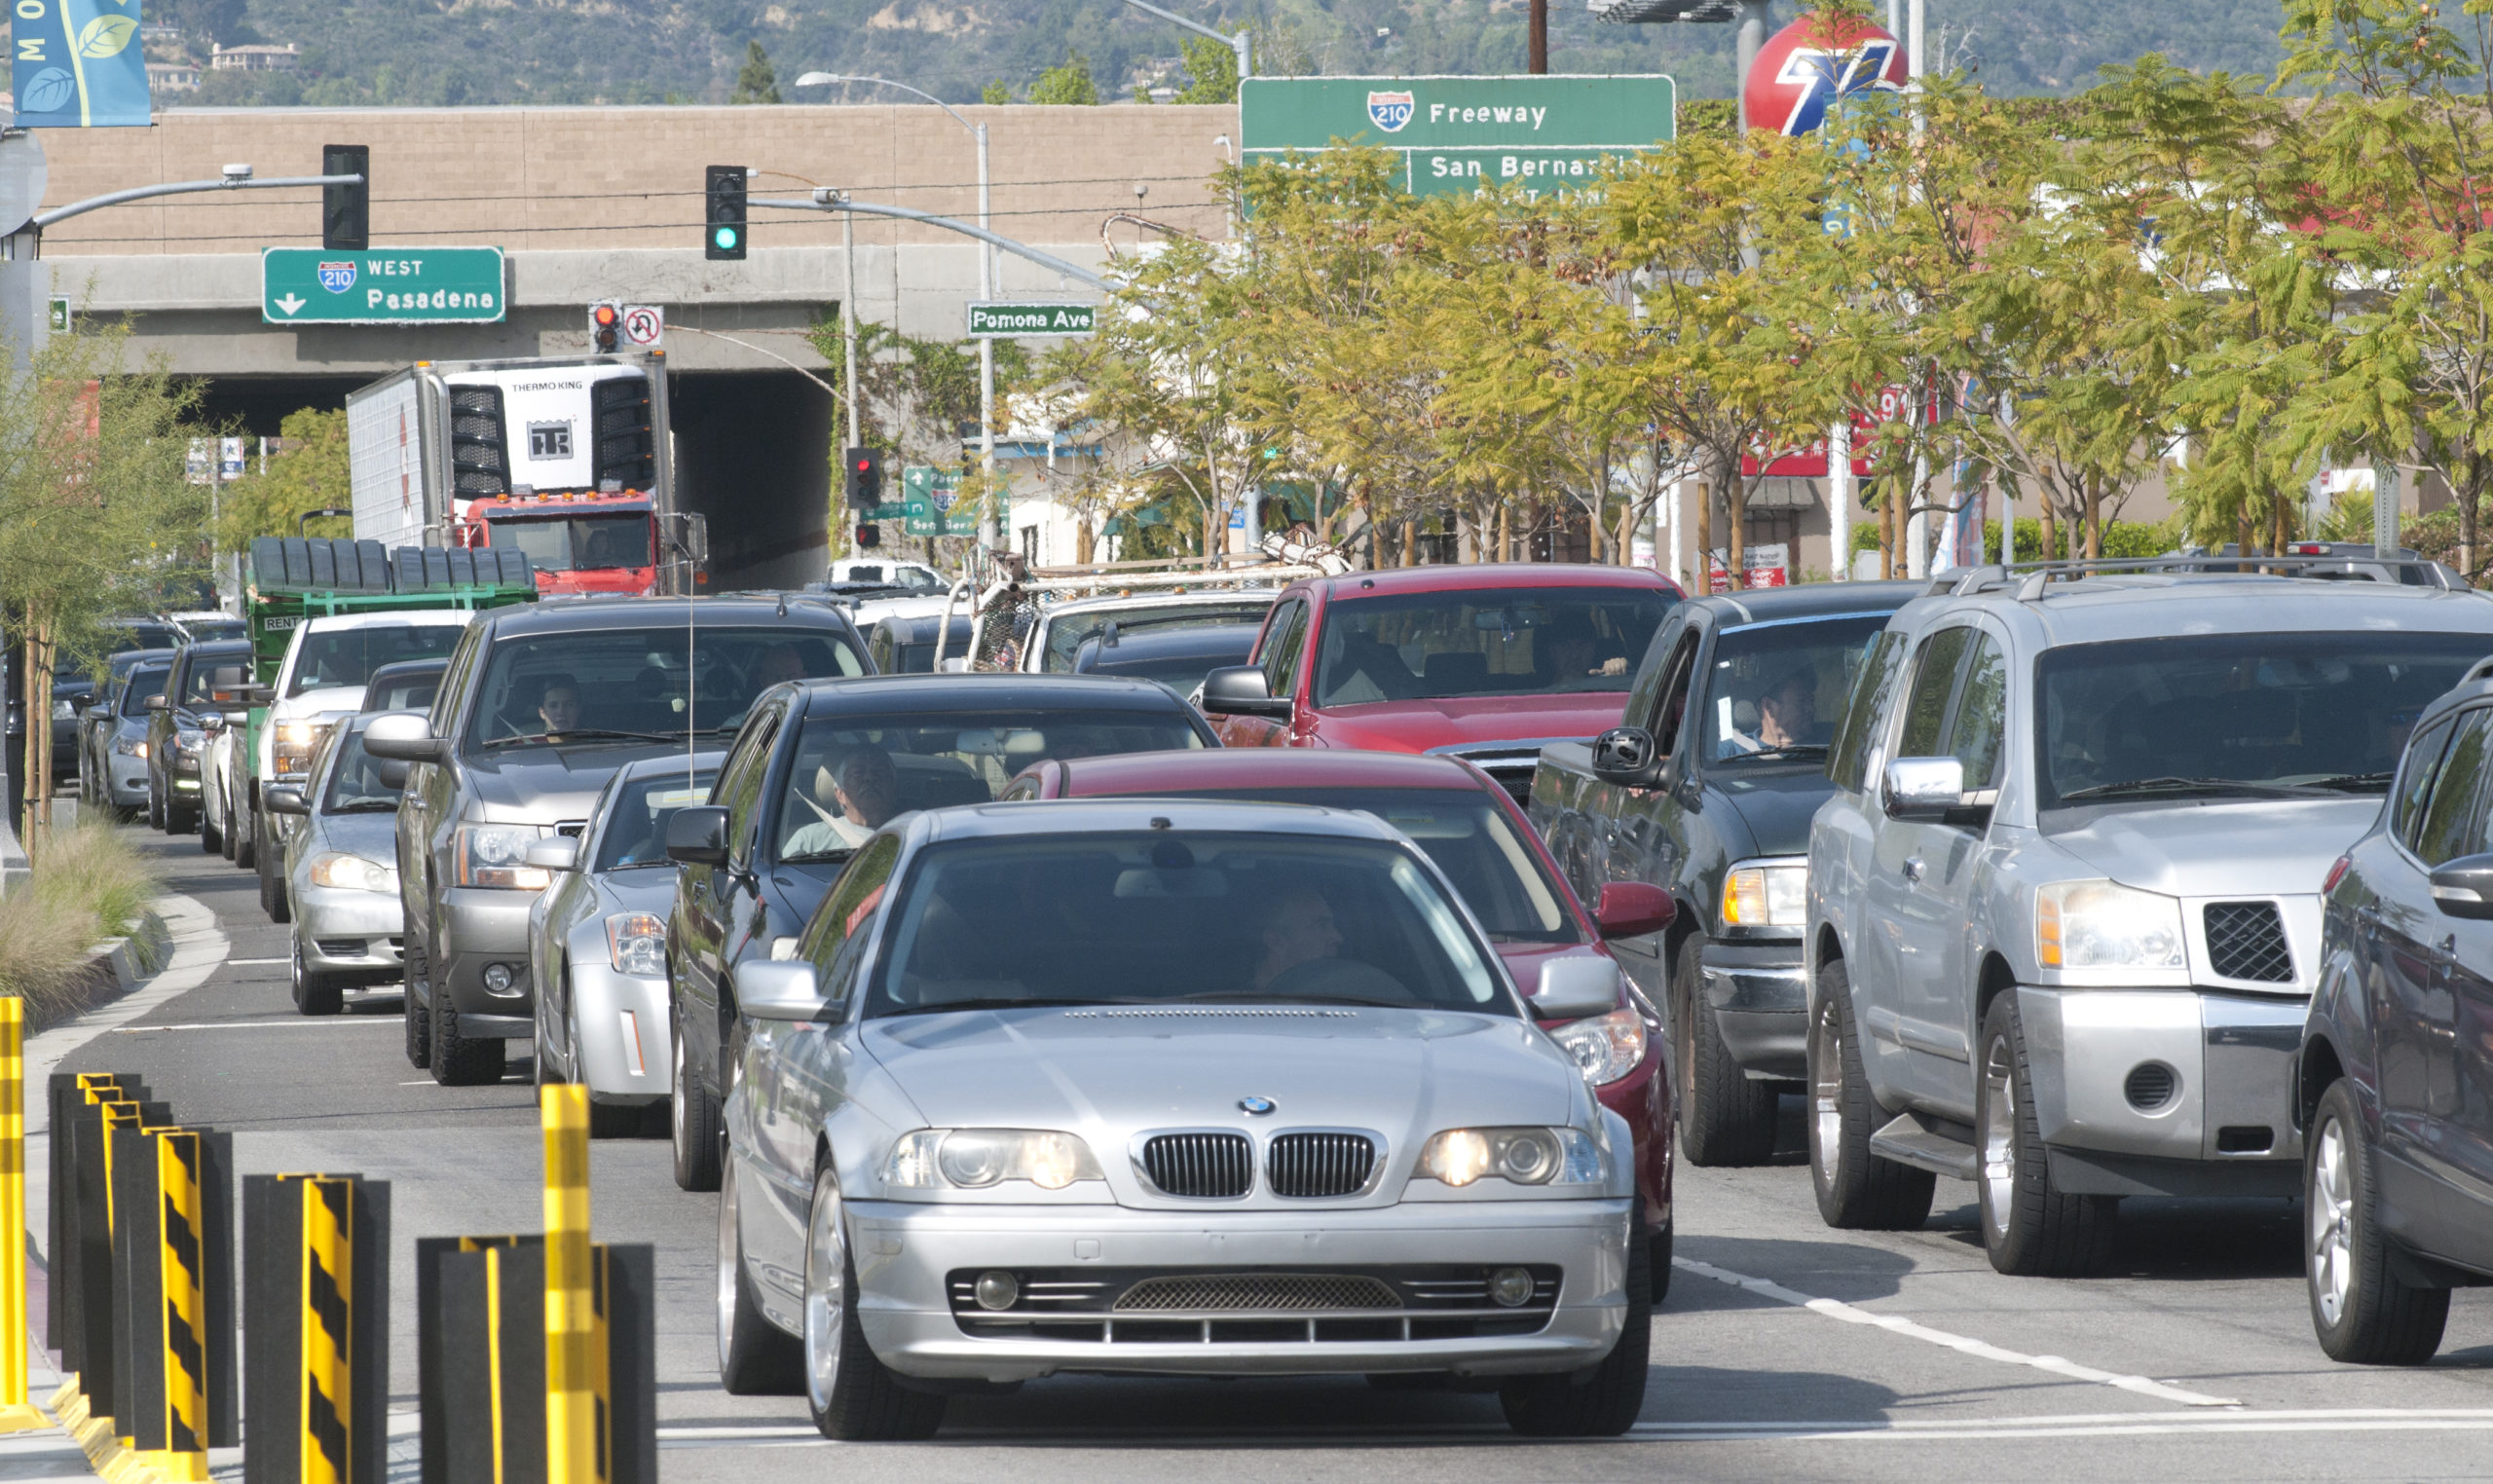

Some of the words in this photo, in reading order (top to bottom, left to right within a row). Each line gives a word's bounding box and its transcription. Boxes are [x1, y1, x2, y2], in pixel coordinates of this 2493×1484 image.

[1377, 105, 1408, 123] 210
[1430, 103, 1546, 130] Freeway
[1431, 156, 1481, 177] San
[367, 260, 423, 276] WEST
[324, 271, 351, 286] 210
[367, 289, 494, 309] Pasadena
[973, 311, 1048, 328] Pomona
[1053, 310, 1091, 328] Ave
[511, 382, 556, 392] THERMO
[557, 381, 582, 390] KING
[266, 617, 299, 629] RENT
